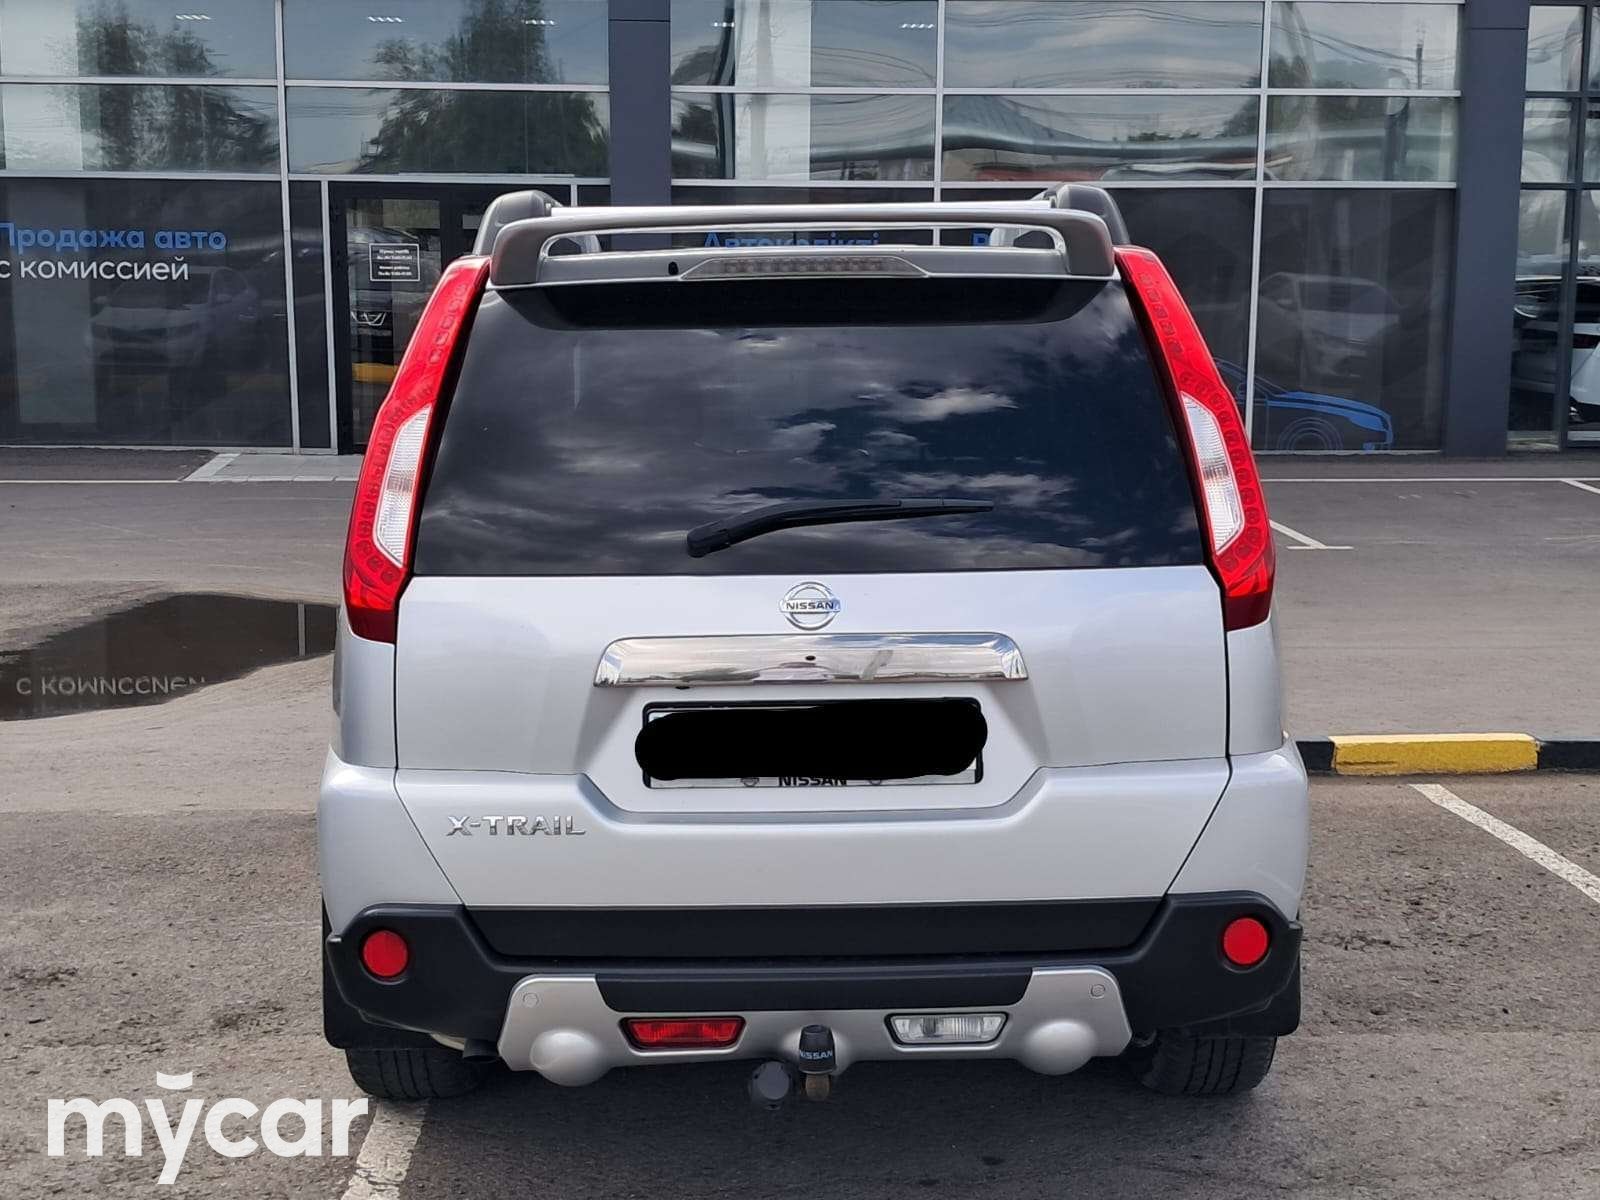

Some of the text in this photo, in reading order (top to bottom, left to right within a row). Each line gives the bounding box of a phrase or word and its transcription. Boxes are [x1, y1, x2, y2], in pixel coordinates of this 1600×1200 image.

[0, 222, 227, 255] Продажа авто
[20, 256, 189, 280] комиссией
[786, 602, 834, 610] NISSAN
[778, 776, 848, 787] NISSAN
[446, 815, 587, 836] X-TRAIL
